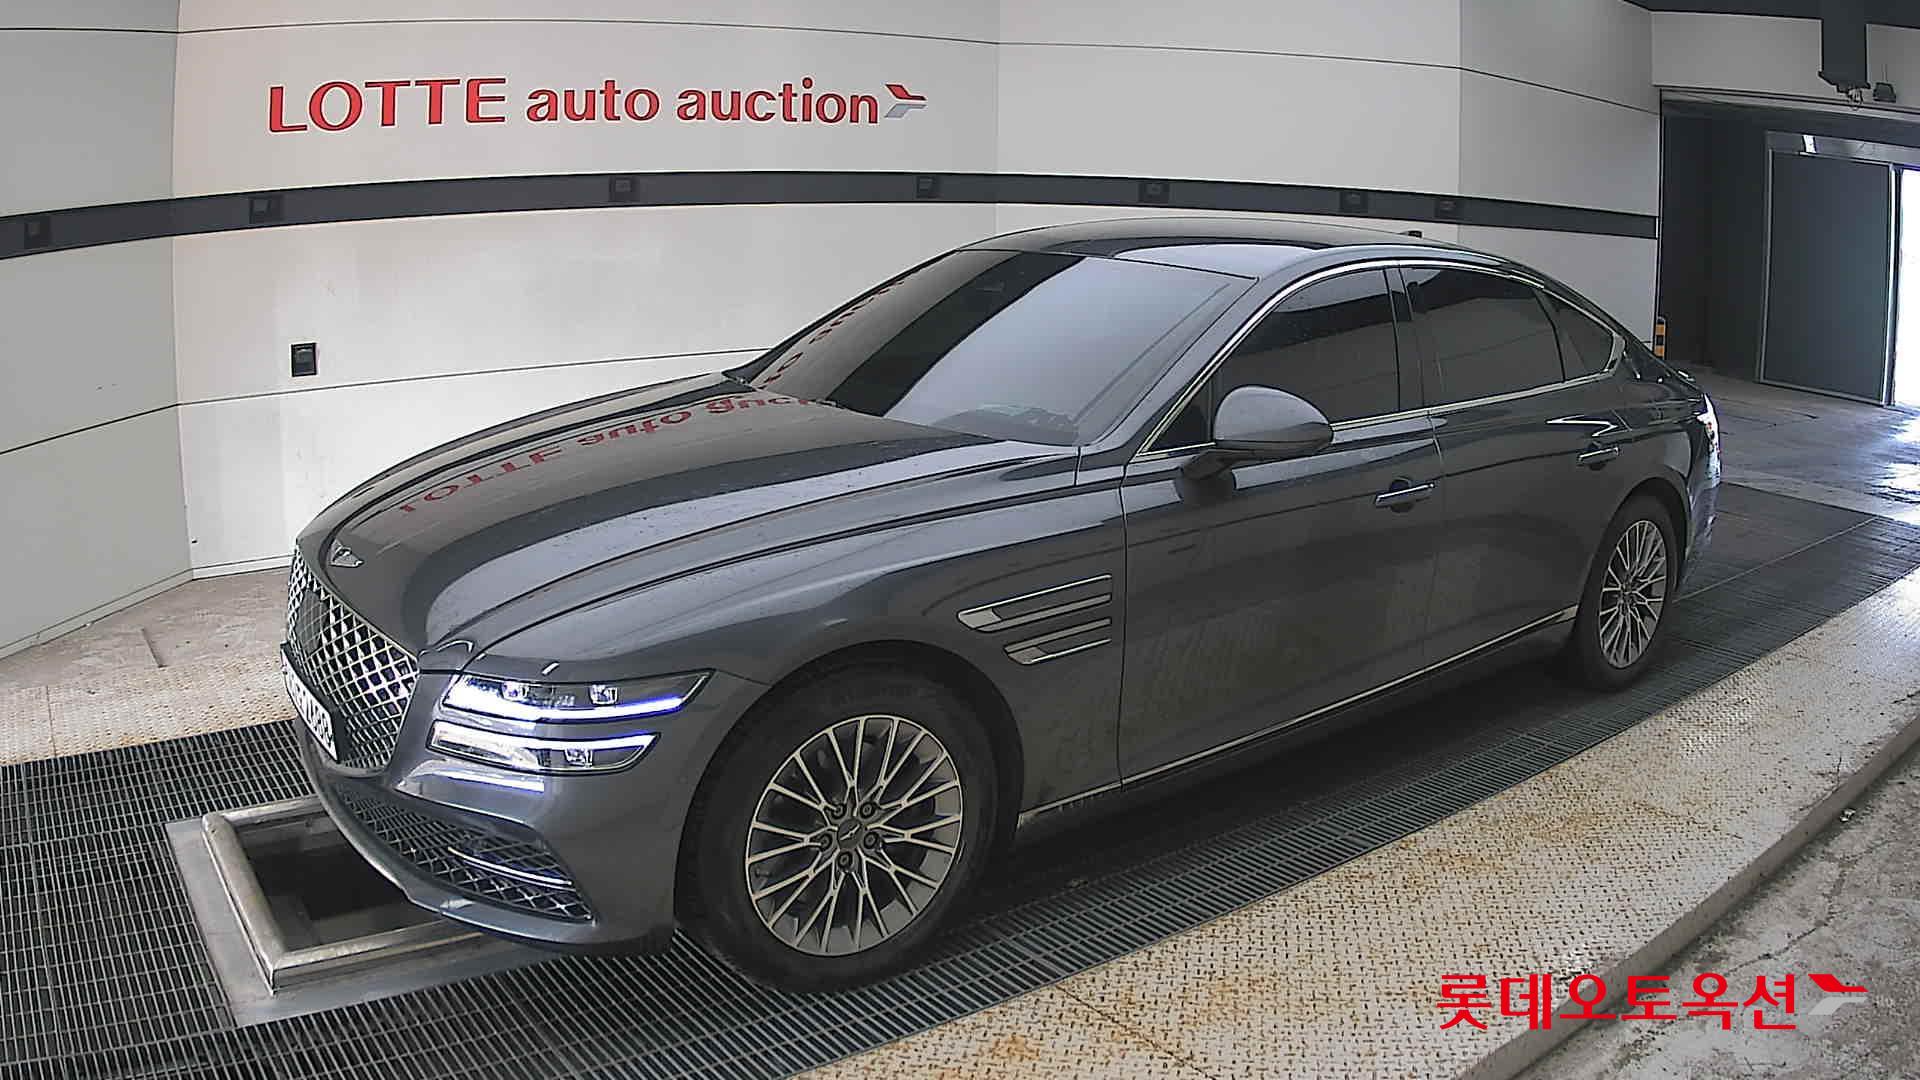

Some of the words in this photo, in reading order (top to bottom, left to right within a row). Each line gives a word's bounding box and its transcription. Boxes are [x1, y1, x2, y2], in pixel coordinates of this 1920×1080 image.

[268, 78, 506, 133] LOTTE
[526, 79, 660, 122] auto
[676, 77, 879, 124] auction
